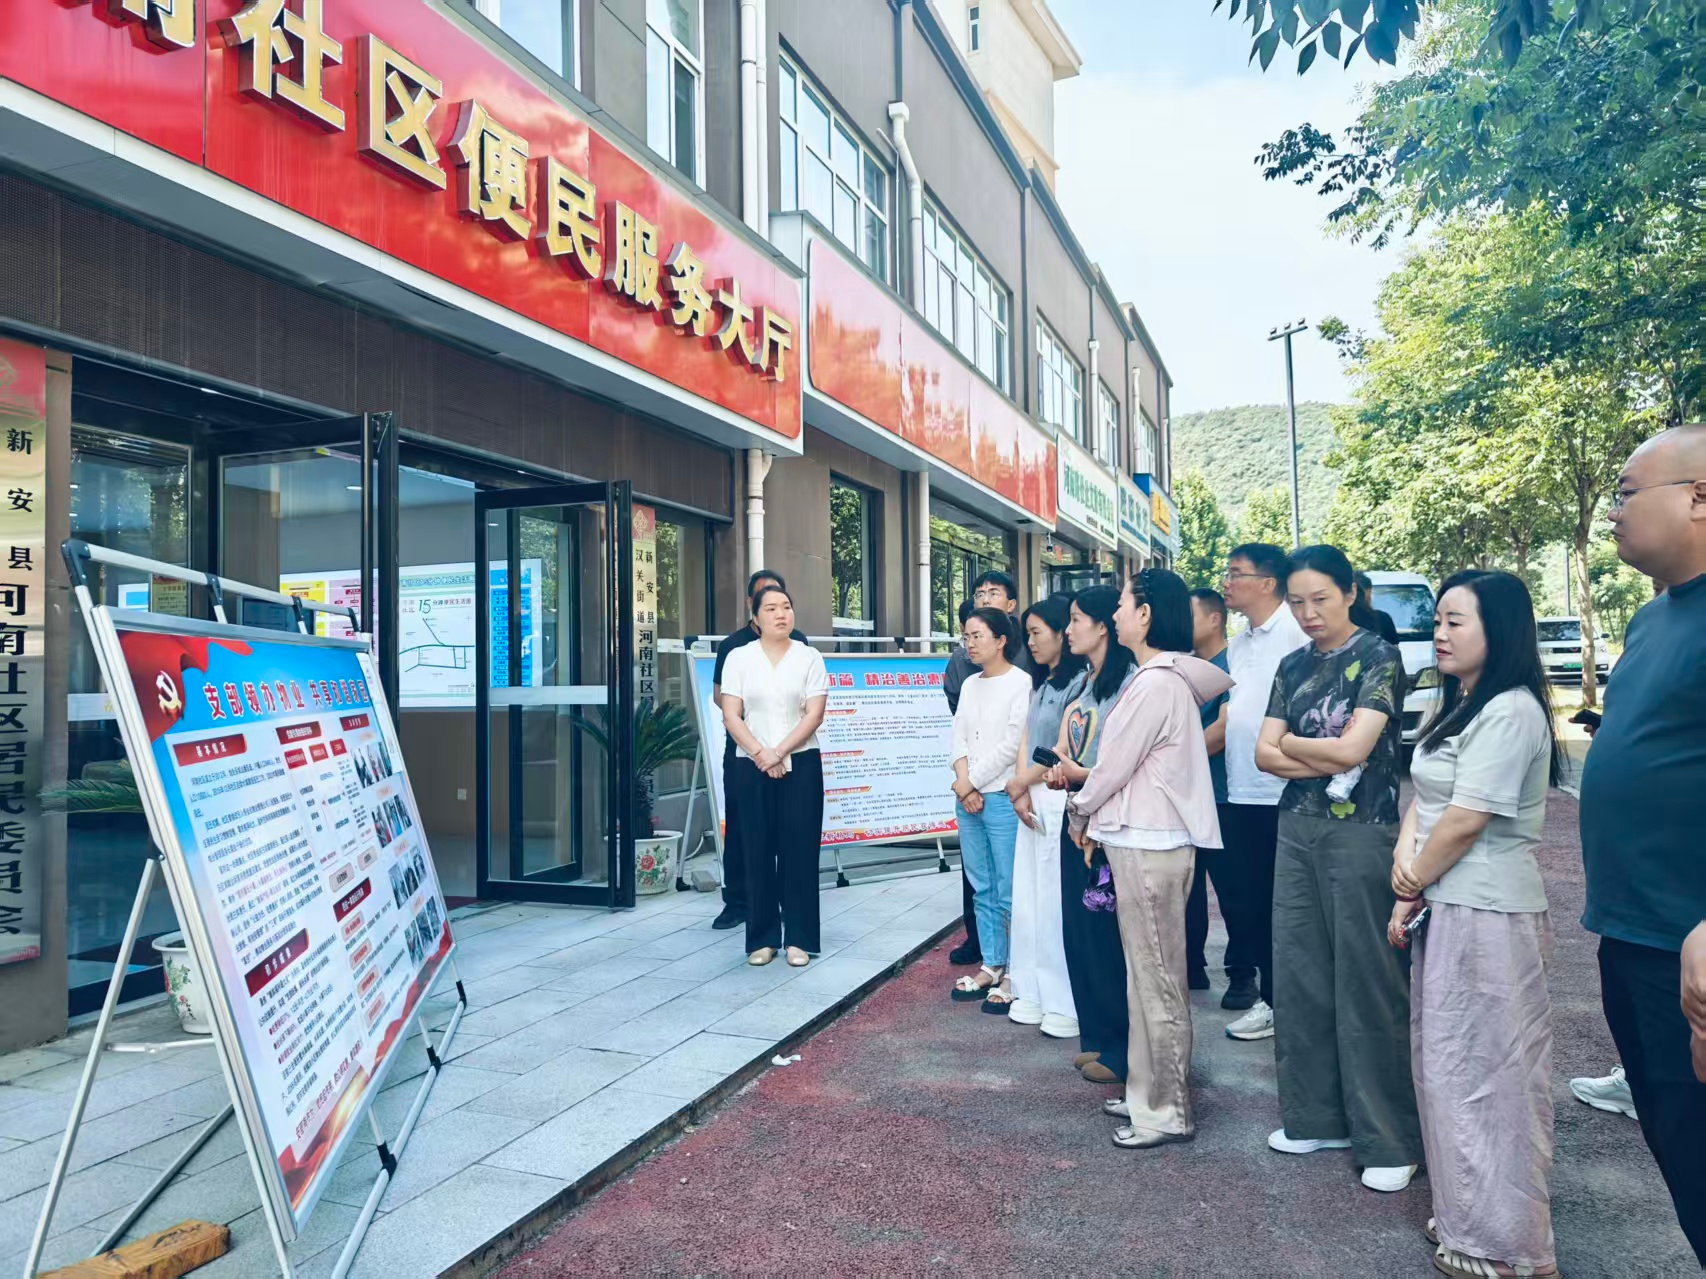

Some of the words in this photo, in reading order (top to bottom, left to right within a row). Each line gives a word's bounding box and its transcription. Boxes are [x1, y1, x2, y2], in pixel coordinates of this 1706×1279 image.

[7, 428, 33, 572] 新安县
[635, 548, 645, 624] 汉关街道
[645, 550, 655, 624] 新安县
[203, 680, 304, 720] 支部领办物业
[309, 679, 369, 706] 共享和谐家园
[865, 672, 946, 687] 精治善治惠
